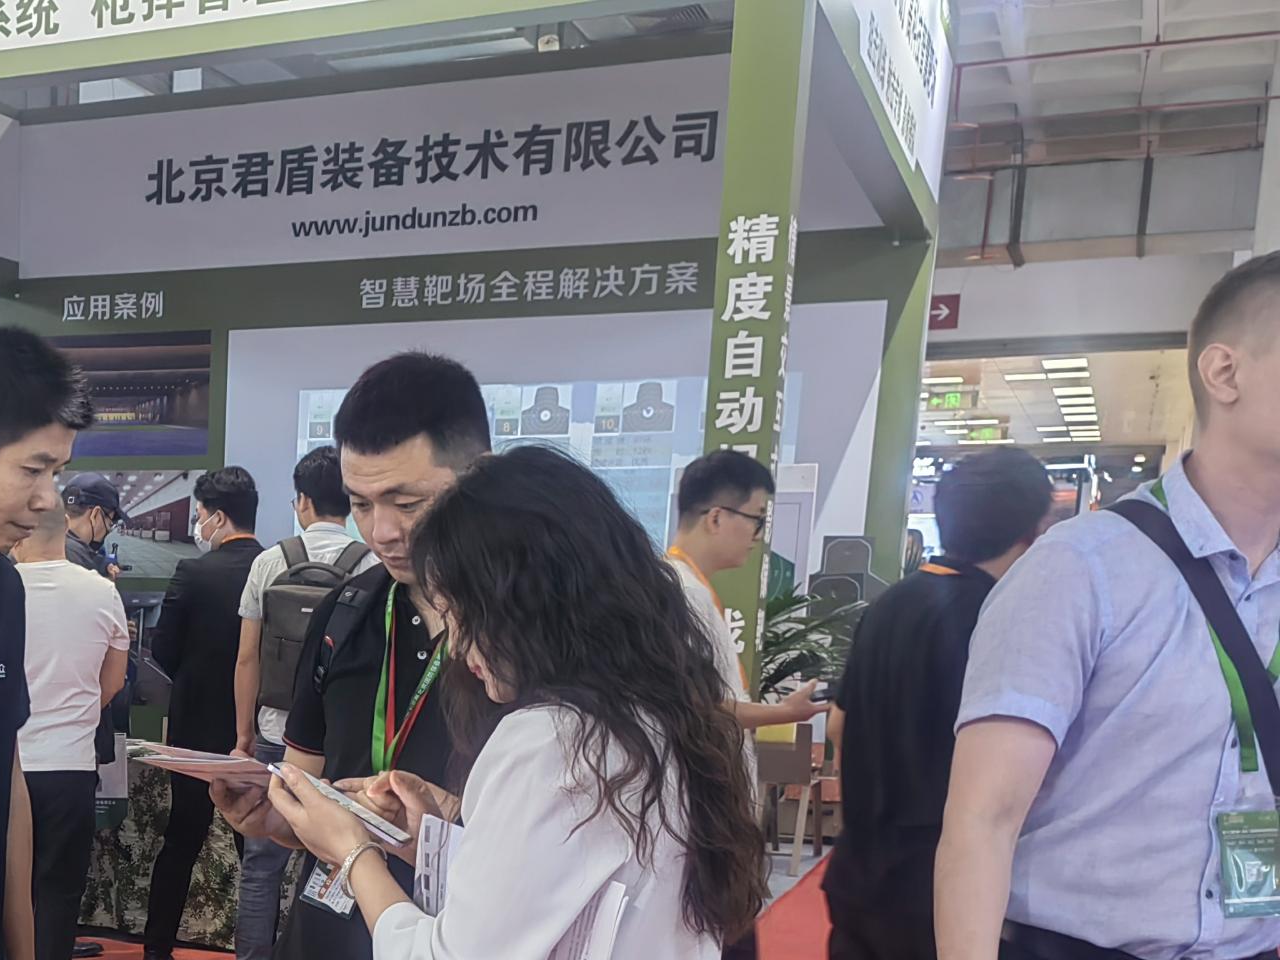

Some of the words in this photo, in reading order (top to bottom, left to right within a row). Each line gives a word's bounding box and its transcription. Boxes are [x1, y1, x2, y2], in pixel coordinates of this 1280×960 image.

[145, 110, 719, 206] 北京君盾装备技术有限公司
[291, 203, 538, 238] www.jundunzb.com
[359, 261, 700, 309] 智慧靶场全程解决方案
[62, 290, 164, 322] 应用案例
